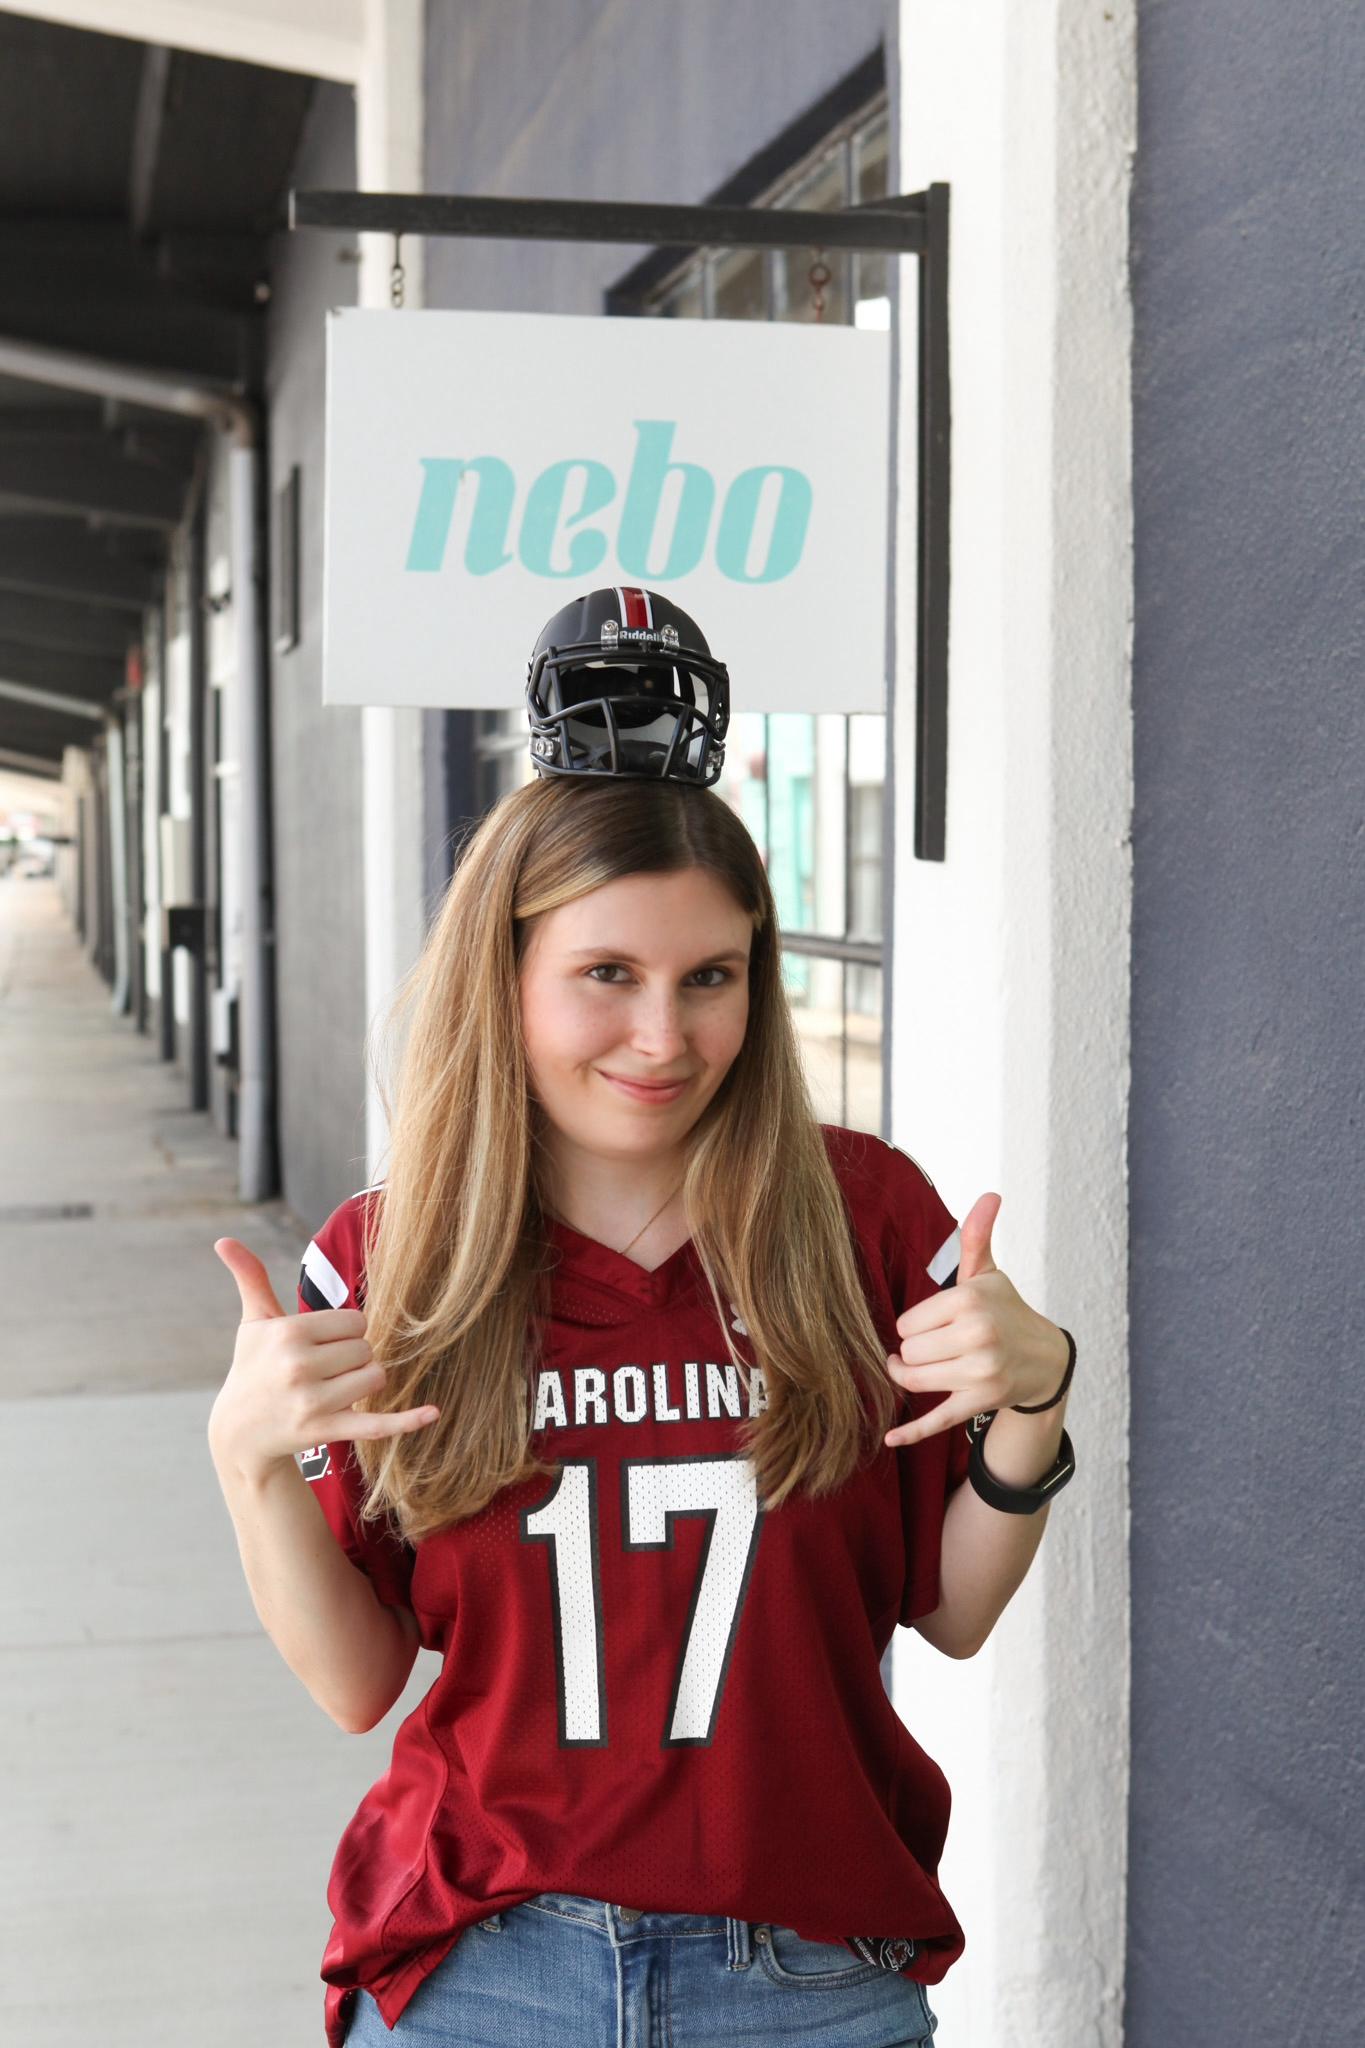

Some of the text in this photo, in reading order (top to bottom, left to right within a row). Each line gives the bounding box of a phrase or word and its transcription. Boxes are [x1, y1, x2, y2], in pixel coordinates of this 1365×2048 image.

[405, 419, 813, 585] nebo
[532, 1362, 769, 1431] AROLINA
[522, 1458, 761, 1745] 17
